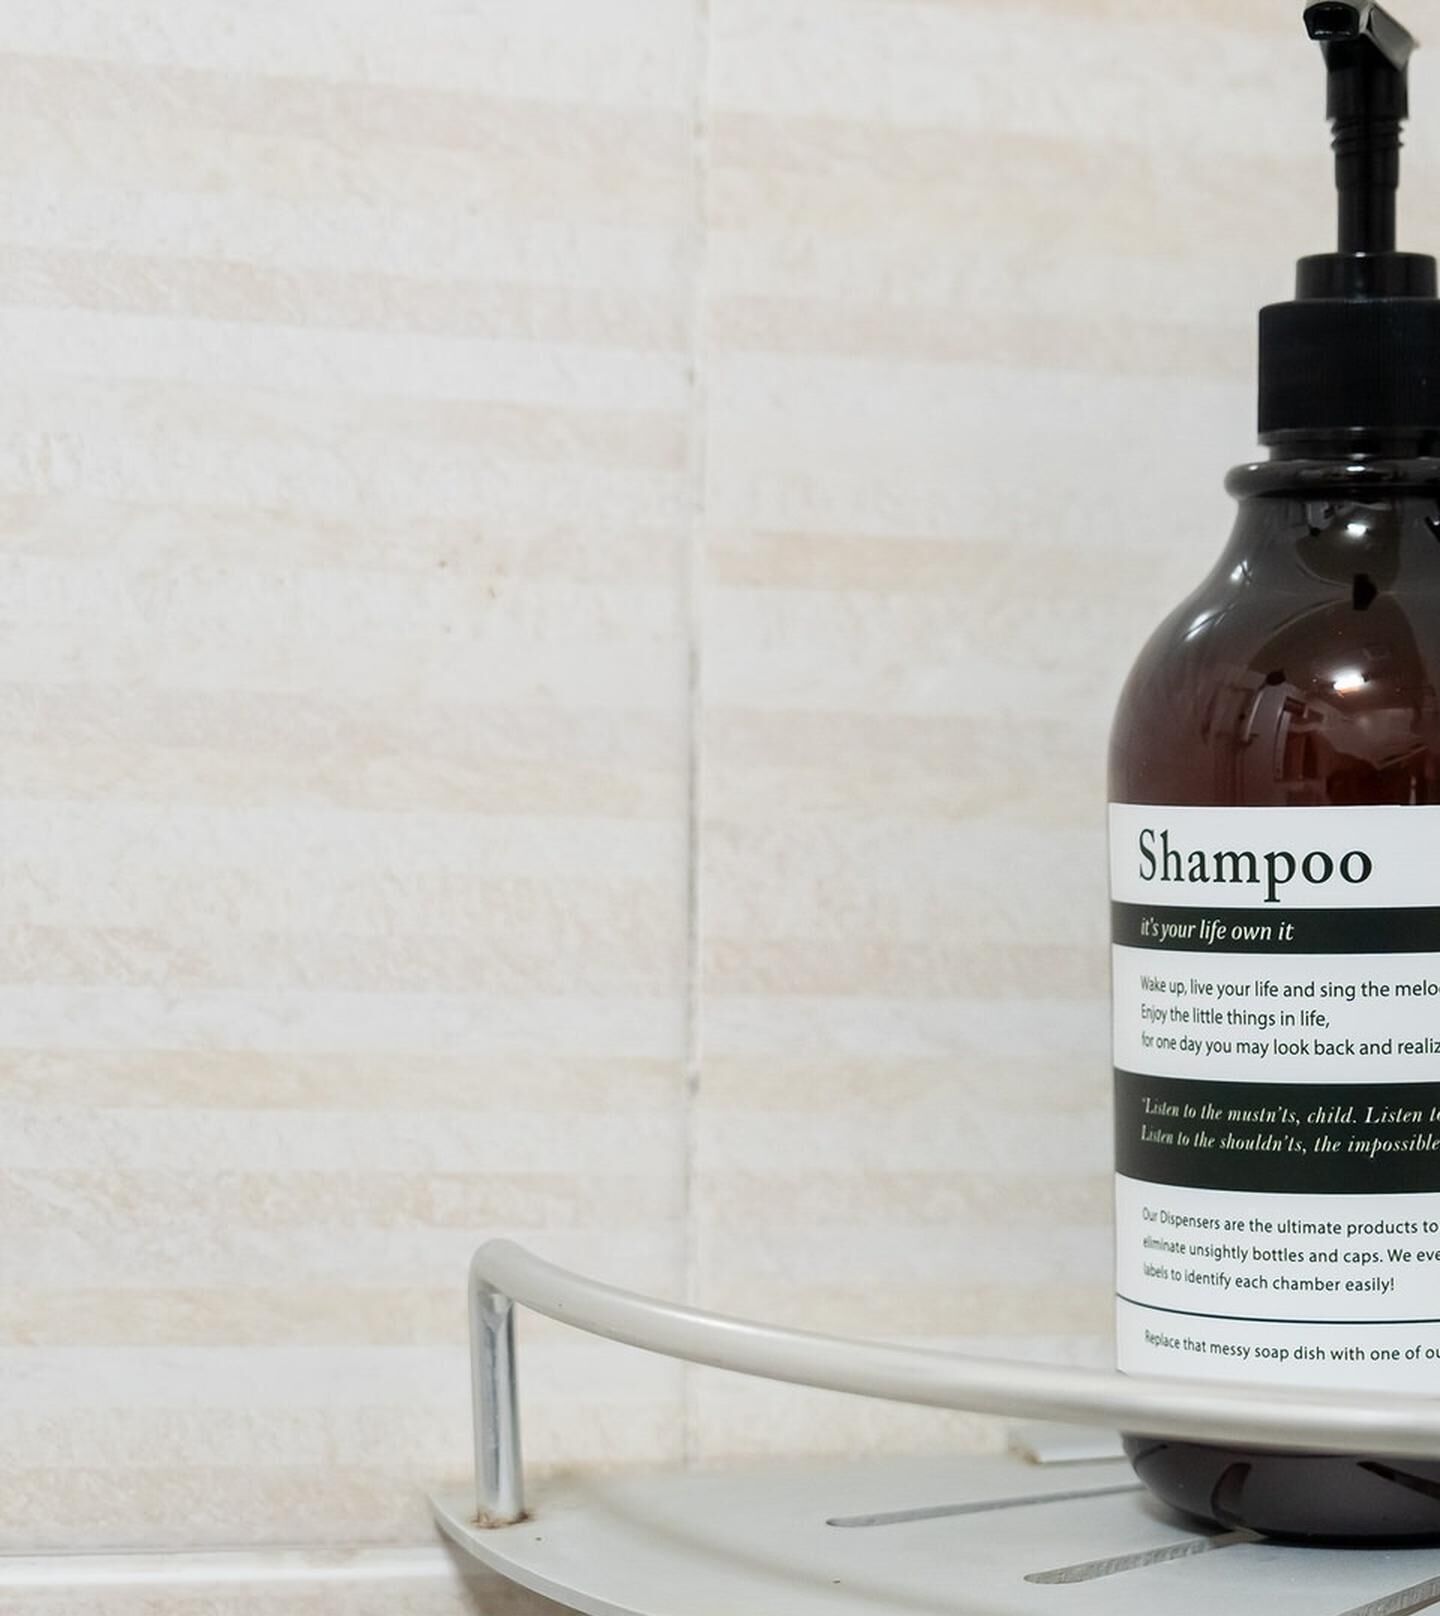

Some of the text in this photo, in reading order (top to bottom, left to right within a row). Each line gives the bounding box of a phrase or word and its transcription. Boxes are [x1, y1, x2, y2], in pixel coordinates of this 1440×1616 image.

[1139, 828, 1373, 903] Shampoo
[1160, 924, 1196, 942] your
[1199, 919, 1227, 945] life
[1231, 927, 1272, 941] own
[1278, 921, 1295, 941] it
[1141, 976, 1167, 993] Wake
[1168, 981, 1188, 998] up,
[1190, 978, 1214, 996] live
[1216, 983, 1252, 1001] your
[1254, 979, 1279, 998] life
[1282, 980, 1315, 998] and
[1319, 981, 1356, 1002] sing
[1360, 980, 1391, 998] the
[1141, 1002, 1330, 1031] Enjoy the little things in life,
[1155, 1036, 1177, 1051] one
[1179, 1034, 1203, 1057] day
[1205, 1040, 1232, 1057] you
[1236, 1041, 1270, 1059] may
[1273, 1037, 1311, 1056] look
[1313, 1038, 1356, 1056] back
[1358, 1037, 1393, 1056] and
[1183, 1103, 1197, 1119] to
[1200, 1102, 1223, 1121] the
[1306, 1105, 1357, 1124] child.
[1364, 1105, 1423, 1124] Listen
[1141, 1124, 1174, 1145] Listen
[1176, 1131, 1191, 1147] to
[1193, 1130, 1216, 1148] the
[1313, 1134, 1342, 1153] the
[1142, 1206, 1158, 1222] Our
[1160, 1209, 1221, 1231] Dispensers
[1223, 1219, 1246, 1232] are
[1248, 1217, 1273, 1234] the
[1277, 1218, 1342, 1235] ultimate
[1346, 1219, 1419, 1239] products
[1422, 1220, 1440, 1234] to
[1188, 1243, 1249, 1264] unsightly
[1252, 1245, 1305, 1263] bottles
[1308, 1248, 1339, 1264] and
[1342, 1251, 1384, 1267] caps.
[1386, 1248, 1412, 1263] We
[1170, 1268, 1182, 1282] to
[1184, 1269, 1232, 1291] identify
[1234, 1274, 1269, 1290] each
[1272, 1275, 1341, 1292] chamber
[1344, 1276, 1395, 1295] easily!
[1145, 1329, 1181, 1350] Replace
[1182, 1337, 1207, 1353] that
[1209, 1343, 1251, 1361] messy
[1254, 1346, 1290, 1363] soap
[1293, 1345, 1326, 1361] dish
[1329, 1346, 1366, 1362] with
[1369, 1349, 1401, 1362] one
[1404, 1344, 1422, 1361] of
